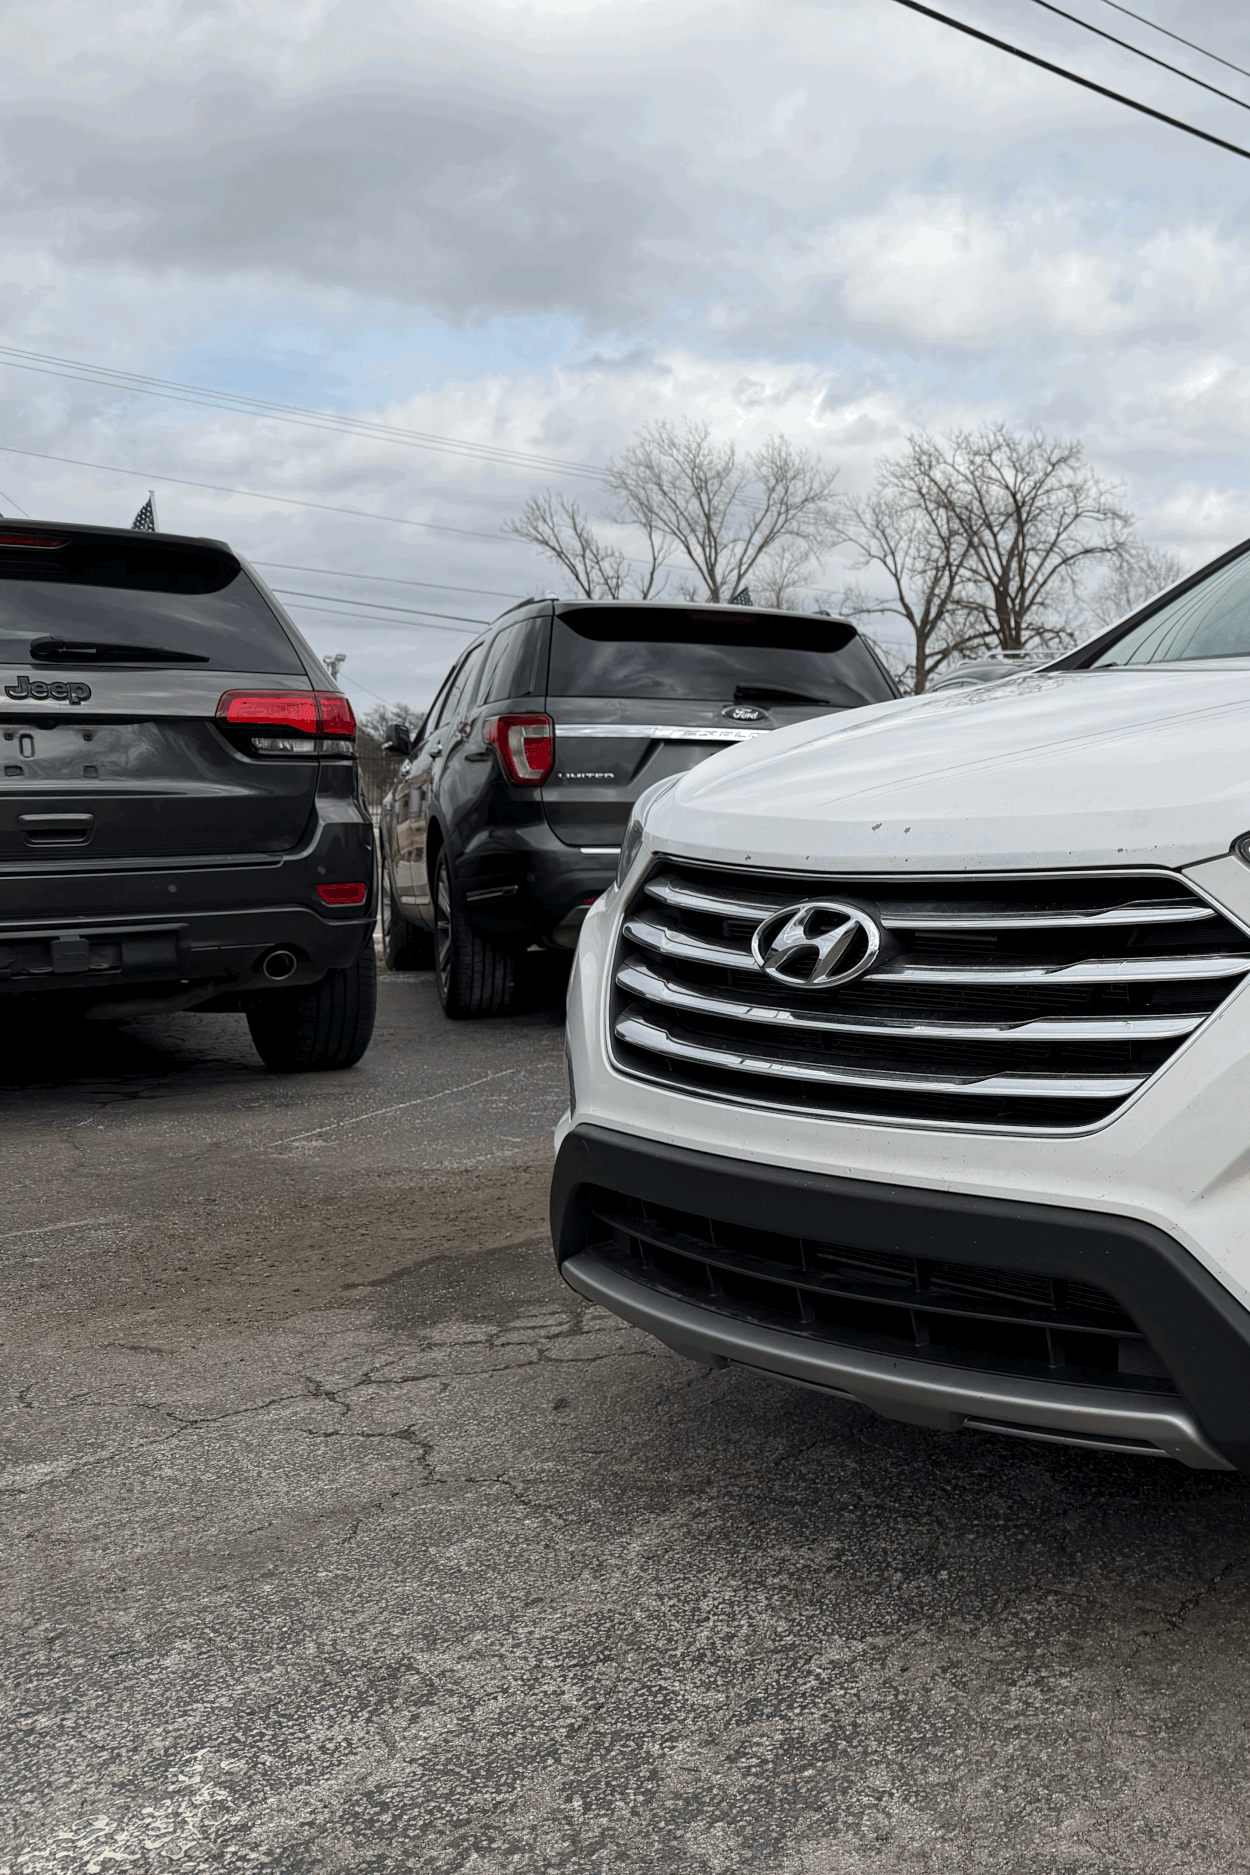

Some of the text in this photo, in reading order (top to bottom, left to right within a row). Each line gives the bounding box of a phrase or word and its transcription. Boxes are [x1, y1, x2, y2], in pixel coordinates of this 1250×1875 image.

[4, 675, 92, 705] Jeep
[732, 708, 759, 720] Ford
[558, 771, 615, 780] LIMITED
